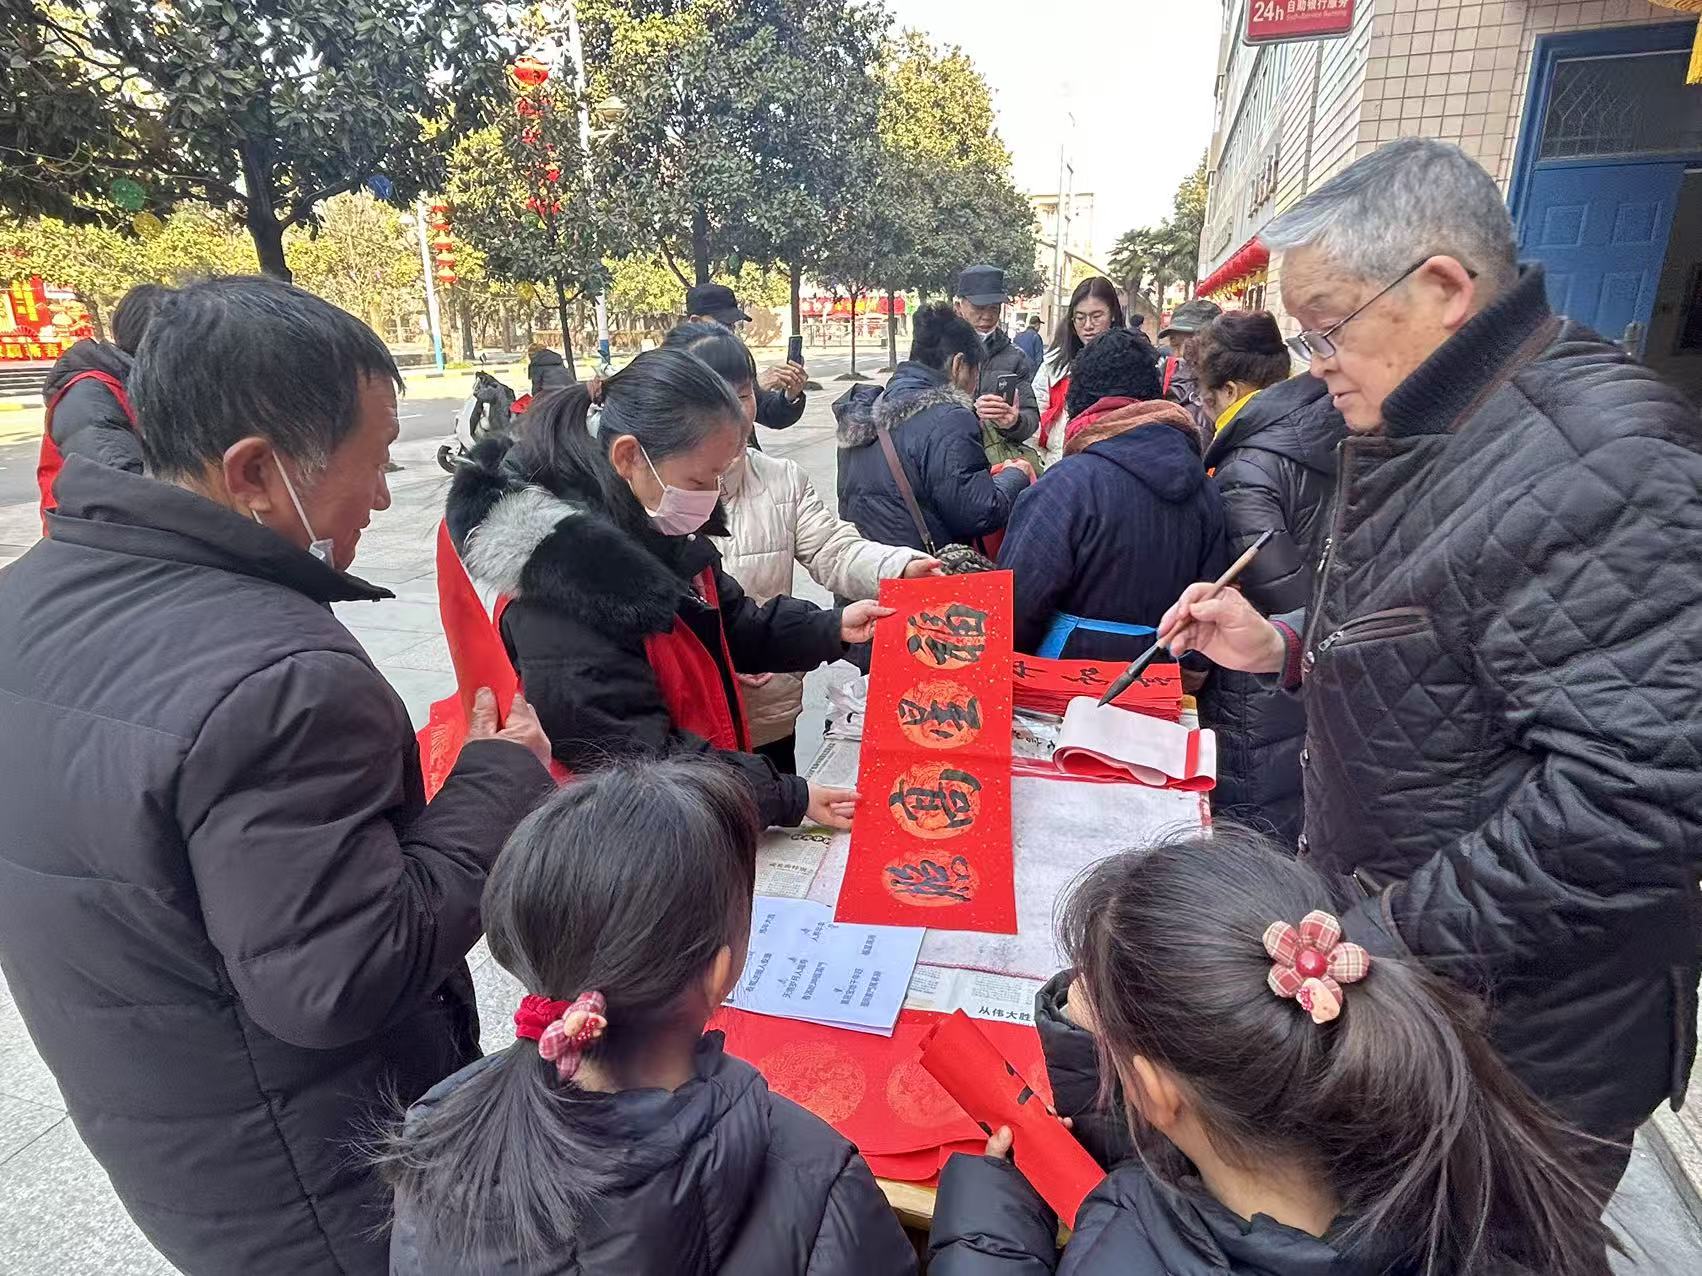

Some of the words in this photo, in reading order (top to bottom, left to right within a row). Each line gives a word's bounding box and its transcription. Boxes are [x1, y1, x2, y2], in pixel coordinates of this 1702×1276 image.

[1253, 1, 1285, 22] 24h
[978, 1005, 1031, 1022] 从伟大胜
